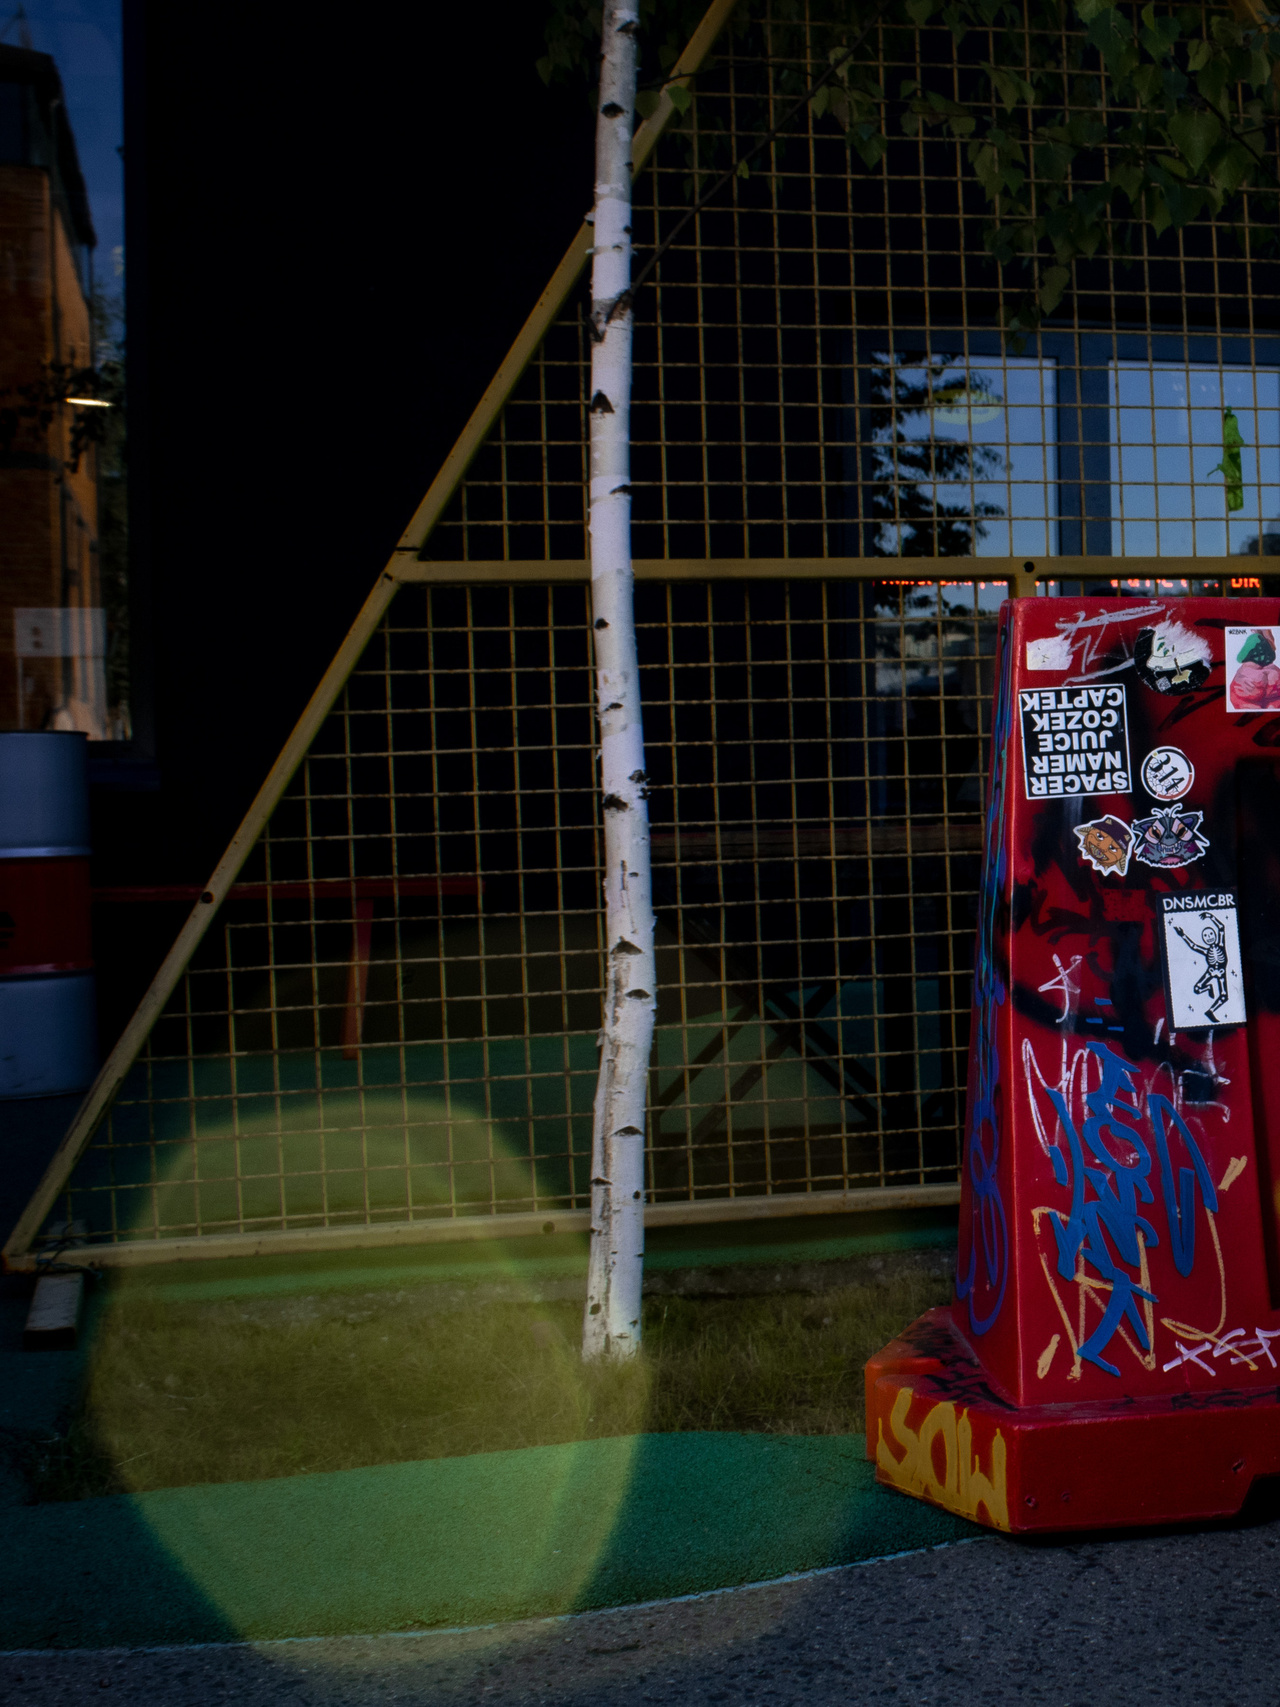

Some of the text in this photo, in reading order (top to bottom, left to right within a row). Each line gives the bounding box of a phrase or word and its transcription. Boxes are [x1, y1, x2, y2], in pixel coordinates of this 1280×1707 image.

[1021, 687, 1124, 711] CAPTEK
[1030, 708, 1118, 732] COZEK
[1037, 730, 1114, 752] JUICE
[1031, 751, 1122, 774] NAMER
[1029, 771, 1128, 795] SPACER
[1162, 893, 1236, 911] DNSMCBR
